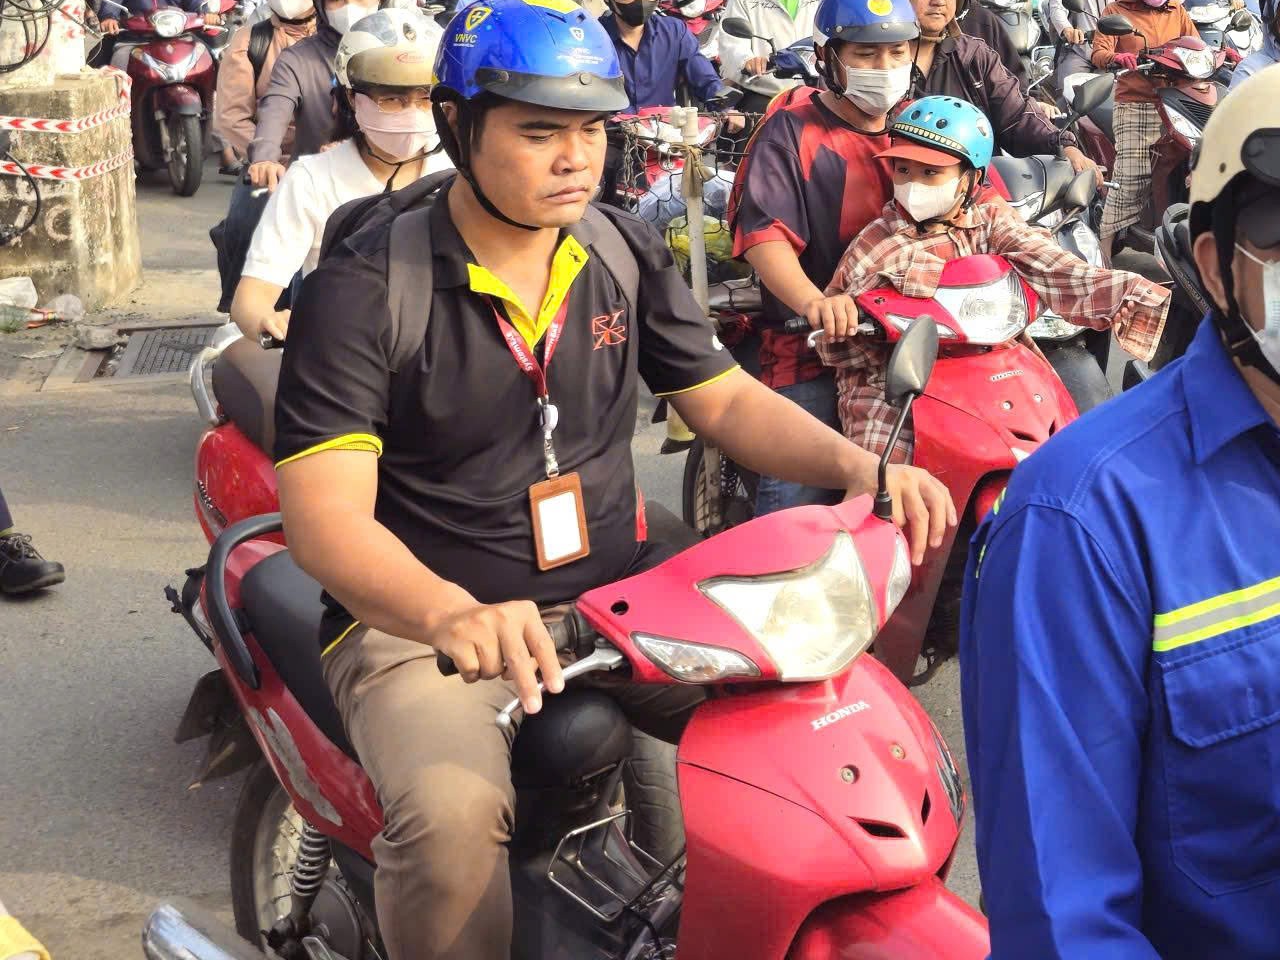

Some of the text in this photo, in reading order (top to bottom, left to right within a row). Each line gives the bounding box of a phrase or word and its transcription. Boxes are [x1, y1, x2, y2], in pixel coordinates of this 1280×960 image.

[455, 33, 478, 44] VNVC
[991, 369, 1024, 382] HONDA
[810, 700, 871, 731] HONDA
